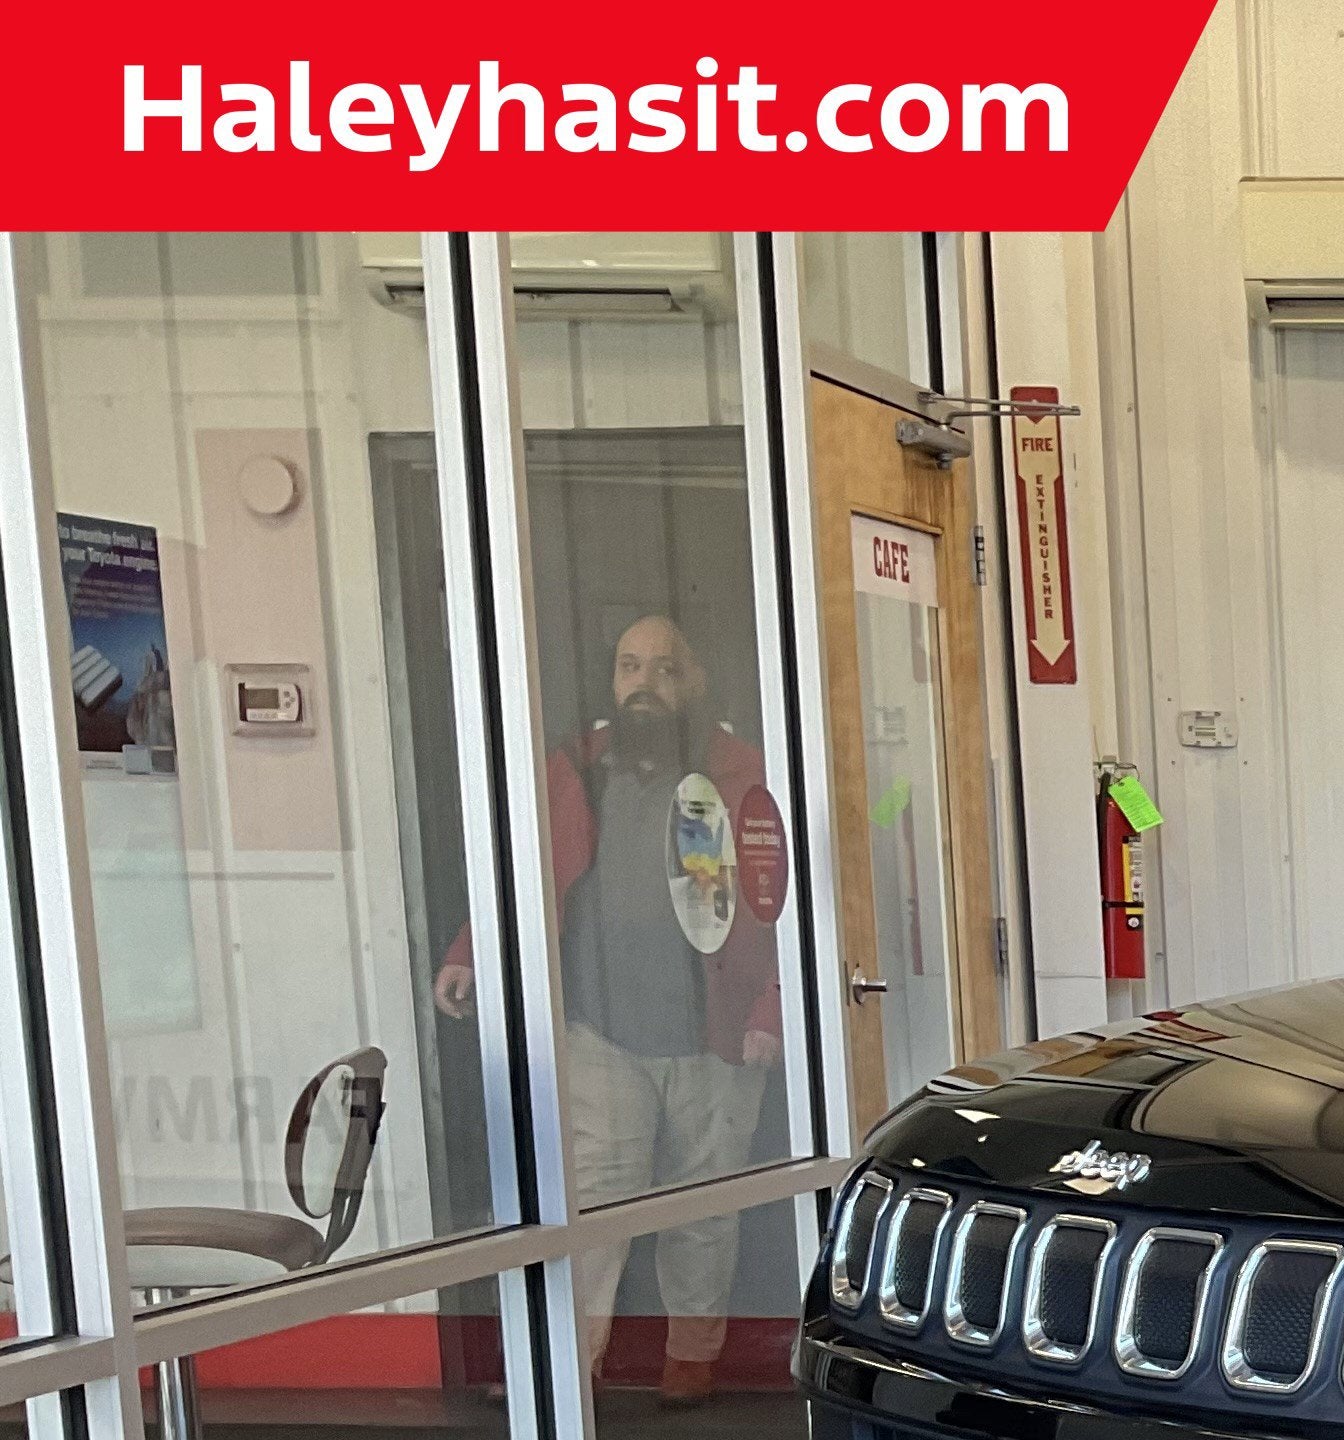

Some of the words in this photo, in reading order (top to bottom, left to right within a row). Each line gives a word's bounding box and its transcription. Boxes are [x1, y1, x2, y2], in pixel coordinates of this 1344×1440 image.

[1021, 437, 1054, 452] FIRE
[873, 536, 910, 584] CAFE
[1035, 474, 1054, 619] EXTINGUISHER
